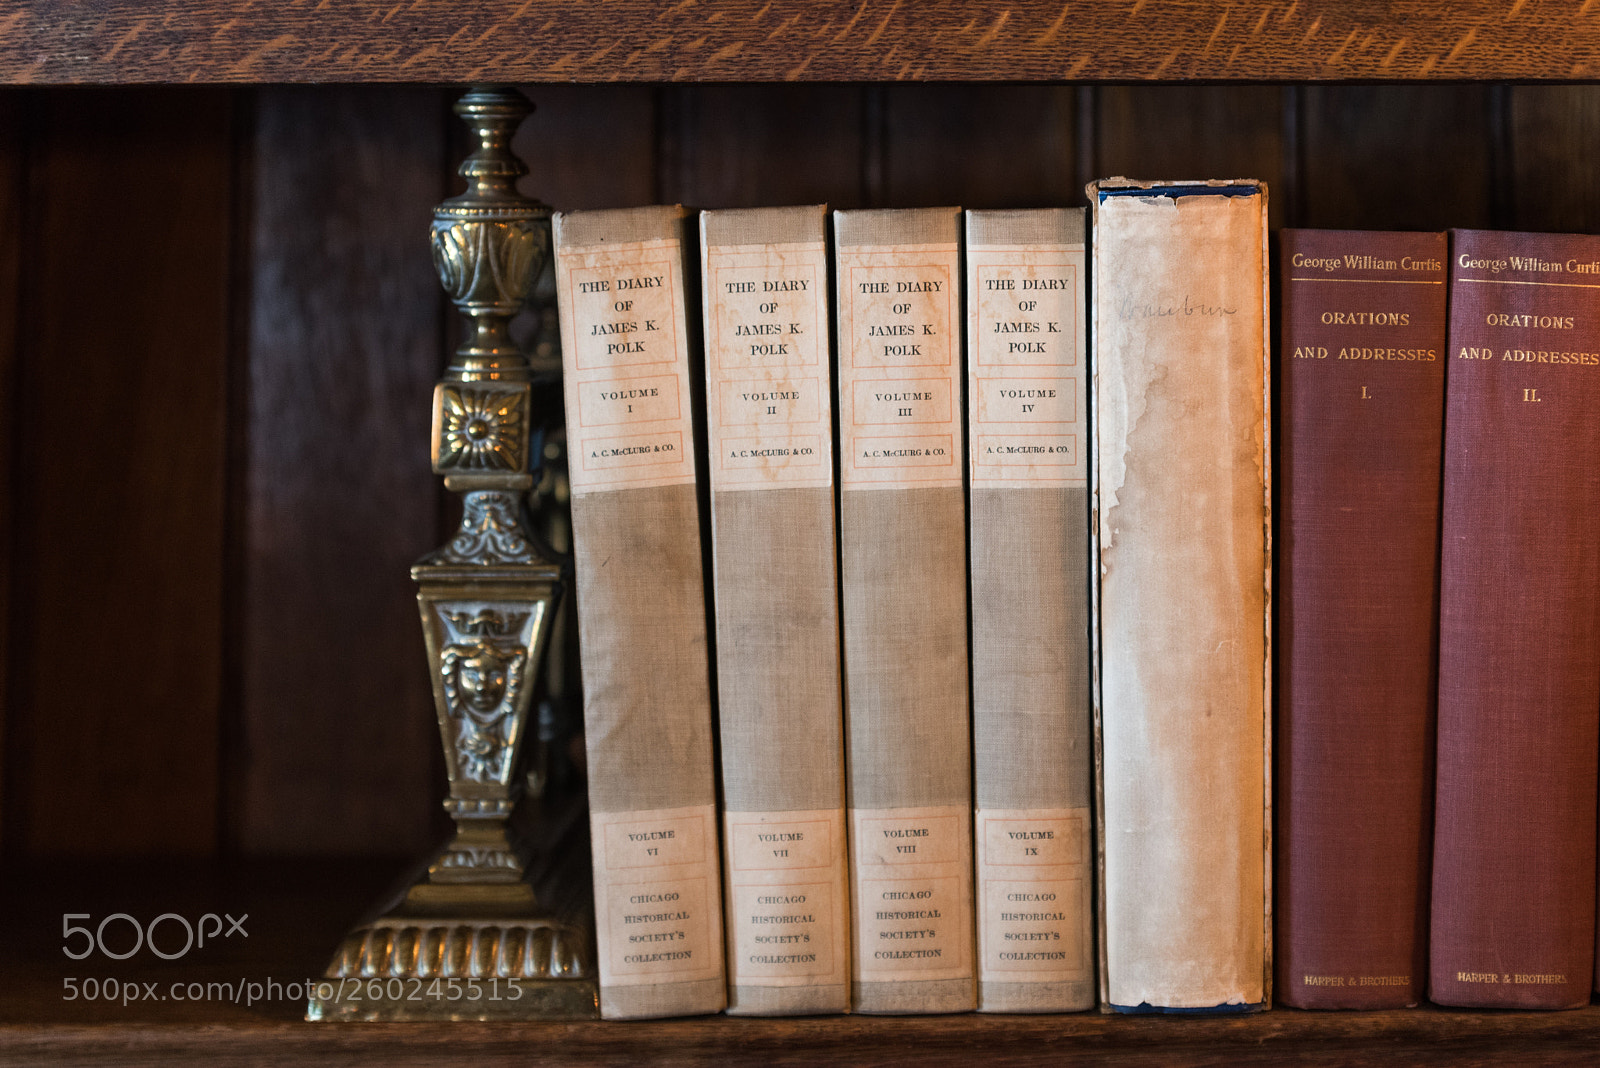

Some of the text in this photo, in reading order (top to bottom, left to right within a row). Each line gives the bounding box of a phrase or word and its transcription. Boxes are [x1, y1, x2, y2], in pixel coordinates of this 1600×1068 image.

[1292, 253, 1441, 272] George William Curtis
[1459, 254, 1600, 274] George William Curti
[579, 277, 664, 293] THE DIARY
[726, 280, 809, 293] THE DIARY
[859, 281, 943, 293] THE DIARY
[986, 279, 1068, 290] THE DIARY
[614, 301, 633, 312] OF
[759, 303, 778, 313] OF
[893, 304, 911, 314] OF
[1018, 301, 1037, 311] OF
[1321, 312, 1410, 325] ORATIONS
[1487, 314, 1574, 329] ORATIONS
[591, 320, 660, 336] JAMES K.
[735, 324, 803, 336] JAMES K.
[869, 325, 936, 336] JAMES K.
[994, 323, 1061, 333] JAMES K.
[607, 342, 645, 354] POLK
[751, 344, 788, 355] POLK
[884, 345, 921, 356] POLK
[1009, 342, 1046, 353] POLK
[1294, 347, 1436, 361] AND ADDRESSES
[1459, 348, 1599, 366] AND ADDRESSES
[601, 388, 659, 400] VOLUME
[742, 392, 799, 401] VOLUME
[875, 392, 932, 401] VOLUME
[1000, 390, 1056, 398] VOLUME
[1362, 386, 1372, 399] I.
[1523, 389, 1541, 402] II.
[628, 405, 632, 413] I
[767, 406, 776, 414] II
[898, 408, 912, 416] III
[1022, 405, 1034, 413] IV
[611, 446, 650, 456] McCLURG
[750, 449, 789, 457] McCLURG
[883, 449, 921, 457] McCLURG
[629, 831, 675, 842] VOLUME
[758, 833, 803, 842] VOLUME
[884, 829, 929, 838] VOLUME
[1008, 831, 1054, 839] VOLUME
[647, 848, 658, 856] VI
[896, 846, 916, 854] VIII
[630, 893, 679, 904] CHICAGO
[758, 896, 806, 904] CHICAGO
[882, 891, 931, 900] CHICAGO
[624, 912, 690, 924] HISTORICAL
[751, 915, 815, 924] HISTORICAL
[876, 910, 941, 919] HISTORICAL
[629, 931, 685, 943] SOCIETY'S
[755, 934, 810, 943] SOCIETY'S
[880, 929, 935, 939] SOCIETY'S
[1004, 932, 1060, 940] SOCIETY'S
[624, 951, 692, 963] COLLECTION
[750, 954, 816, 963] COLLECTION
[875, 950, 941, 959] COLLECTION
[999, 952, 1066, 960] COLLECTION
[1304, 976, 1411, 986] HARPER & BROTHERS
[1457, 972, 1567, 984] HARPER & BROTHERS
